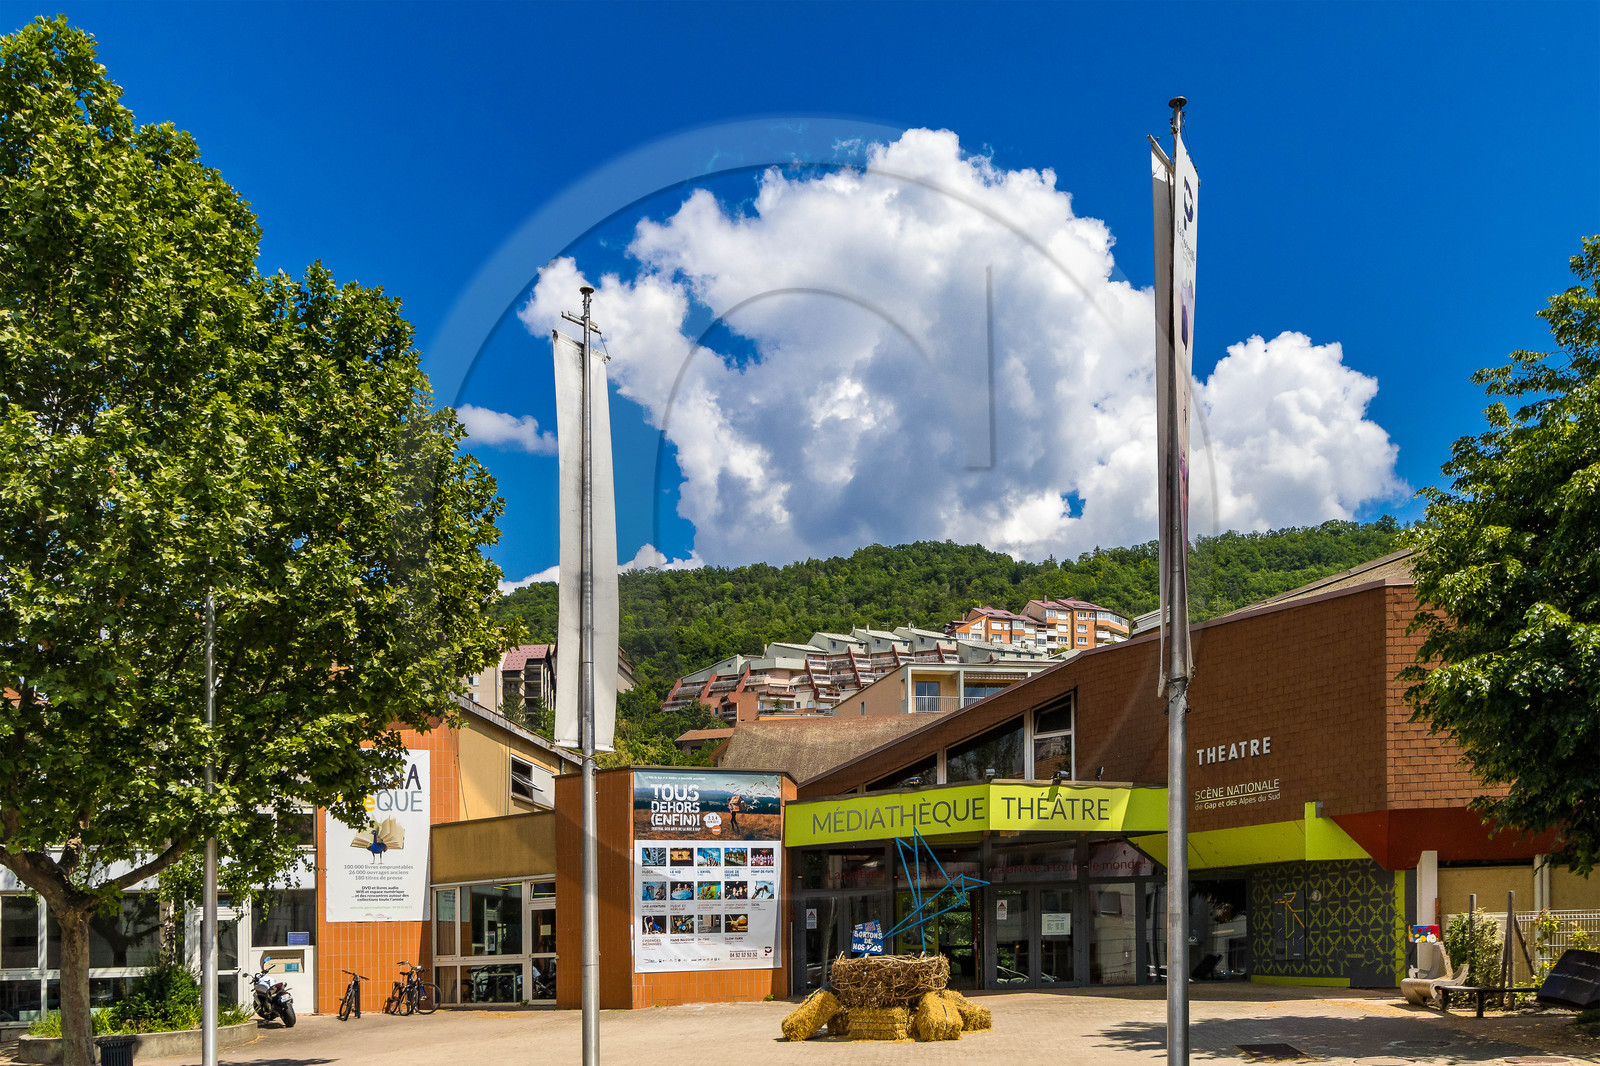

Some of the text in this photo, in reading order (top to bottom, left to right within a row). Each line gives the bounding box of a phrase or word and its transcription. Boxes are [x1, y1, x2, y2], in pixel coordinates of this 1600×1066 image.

[1196, 736, 1271, 766] THEATRE
[650, 783, 700, 801] TOUS
[1195, 778, 1280, 801] SCÈNE NATIONALE
[651, 801, 700, 813] DEHORS
[1001, 792, 1110, 821] THÉÂTRE
[1195, 803, 1203, 811] de
[1204, 802, 1217, 810] Gap
[1226, 799, 1237, 807] des
[1239, 795, 1257, 805] Alpes
[1267, 792, 1281, 800] Sud
[651, 813, 700, 826] (ENFIN)!
[812, 797, 985, 835] MÉDIATHÈQUE
[1007, 863, 1041, 874] arrive
[1089, 859, 1100, 871] le
[854, 930, 882, 940] SORTONS
